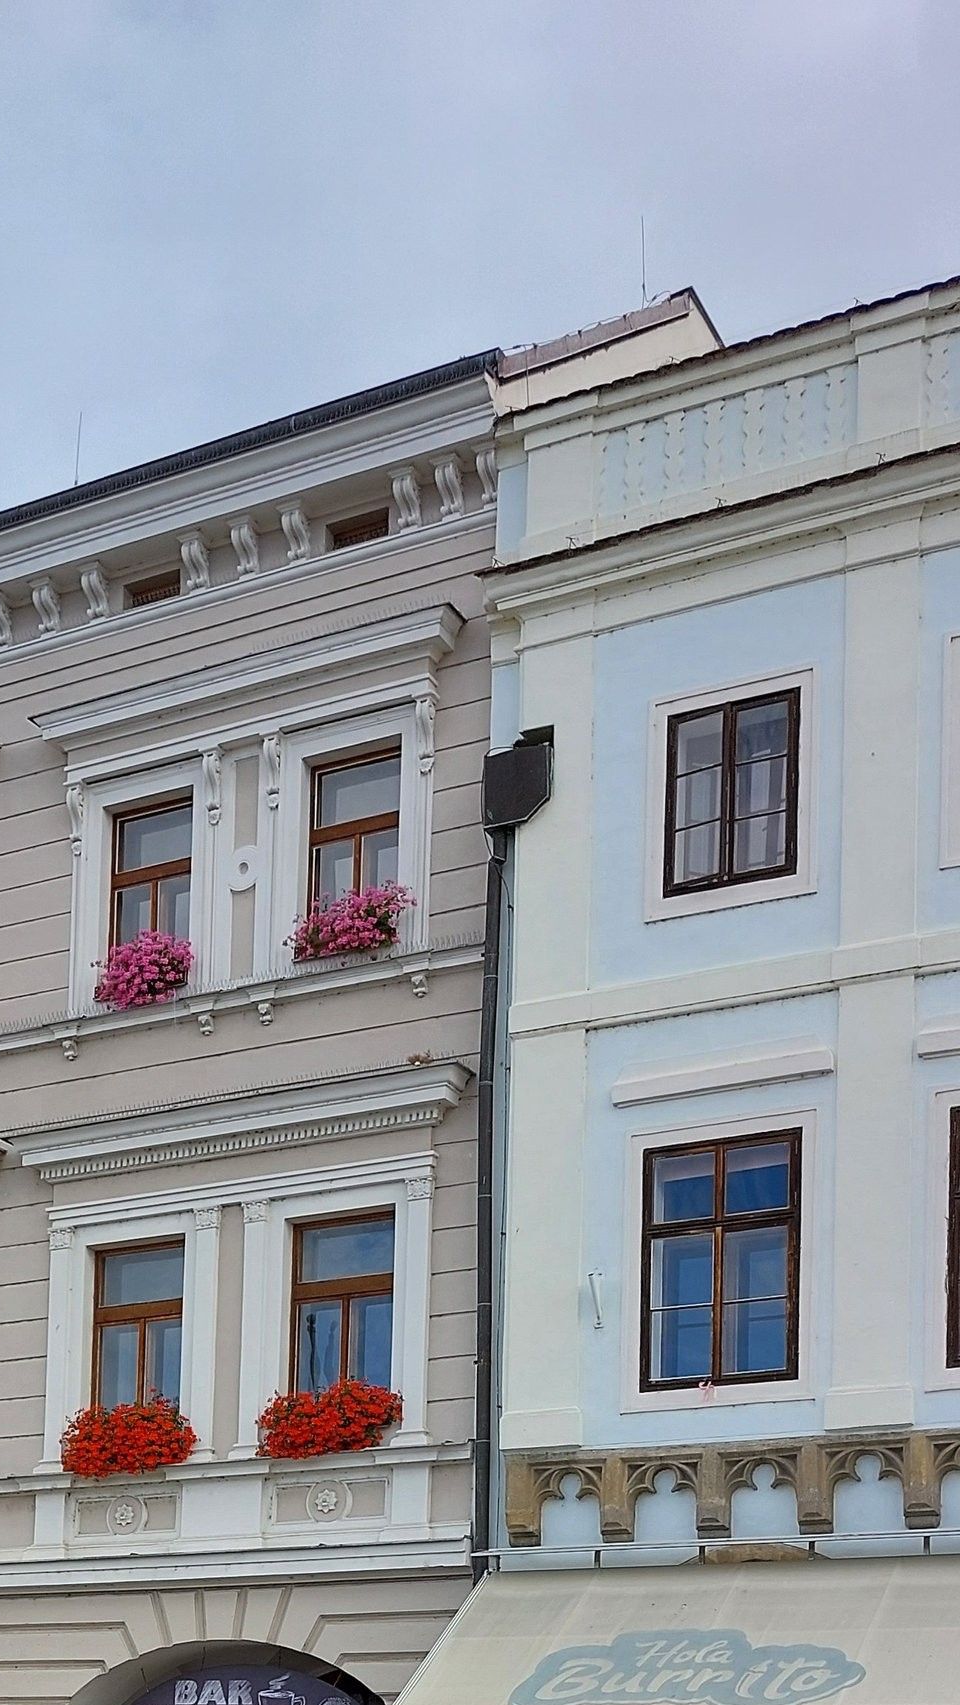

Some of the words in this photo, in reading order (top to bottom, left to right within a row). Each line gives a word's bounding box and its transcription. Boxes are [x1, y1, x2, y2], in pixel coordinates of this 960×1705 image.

[635, 1640, 734, 1668] Hola
[174, 1680, 253, 1705] BAR
[534, 1658, 841, 1700] Burrito
